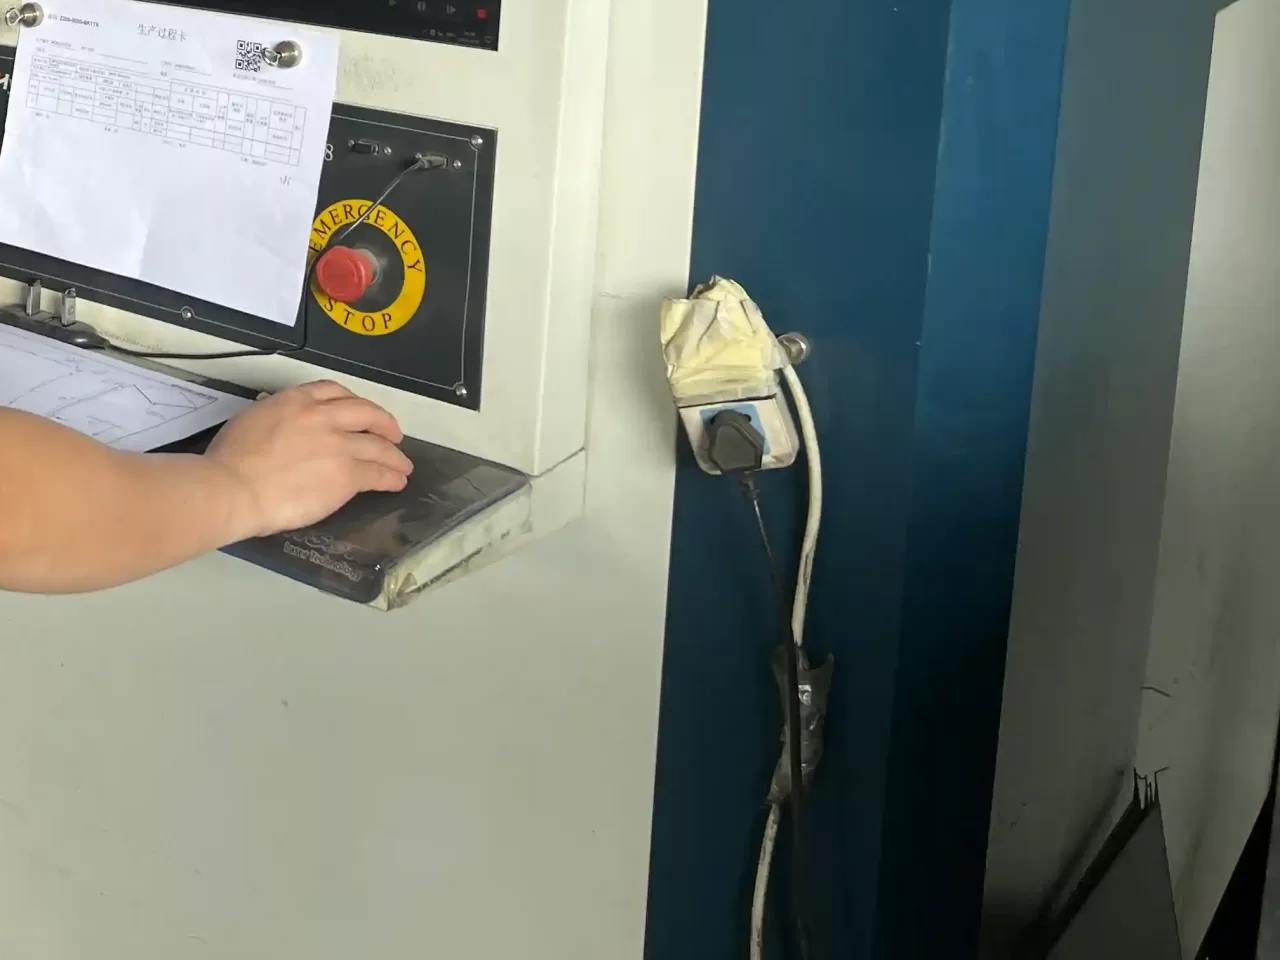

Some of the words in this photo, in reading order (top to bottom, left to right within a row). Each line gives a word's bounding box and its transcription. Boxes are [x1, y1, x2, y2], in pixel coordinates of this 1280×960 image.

[136, 23, 188, 42] 生产过程卡
[309, 204, 423, 273] EMERGENCY
[324, 297, 392, 332] STOP
